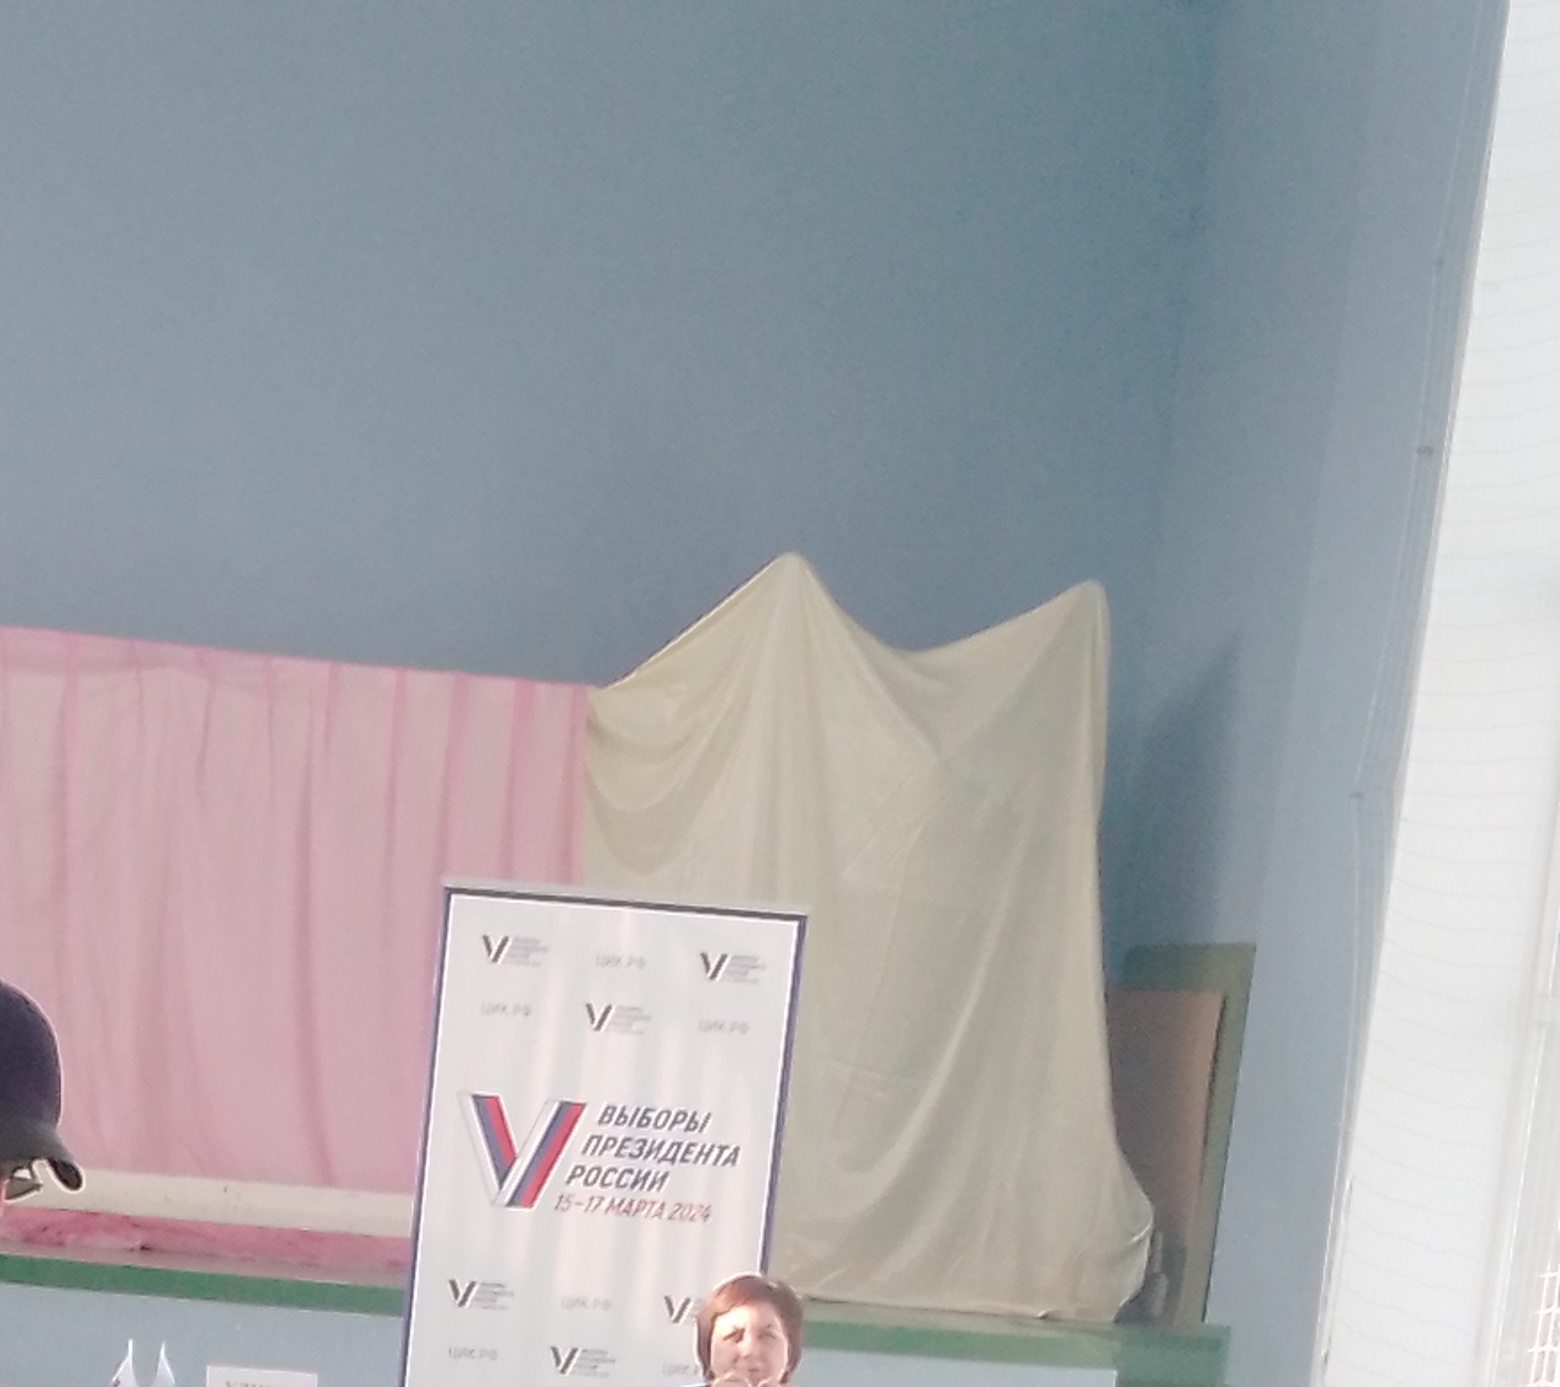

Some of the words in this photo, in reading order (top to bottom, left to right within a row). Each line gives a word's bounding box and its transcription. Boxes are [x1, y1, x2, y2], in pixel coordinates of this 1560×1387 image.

[598, 1103, 712, 1133] ВЫБОРЫ
[582, 1134, 740, 1167] ПРЕЗИДЕНТА
[566, 1165, 670, 1192] РОССИИ
[604, 1196, 666, 1220] МАРТА
[667, 1202, 712, 1222] 2024
